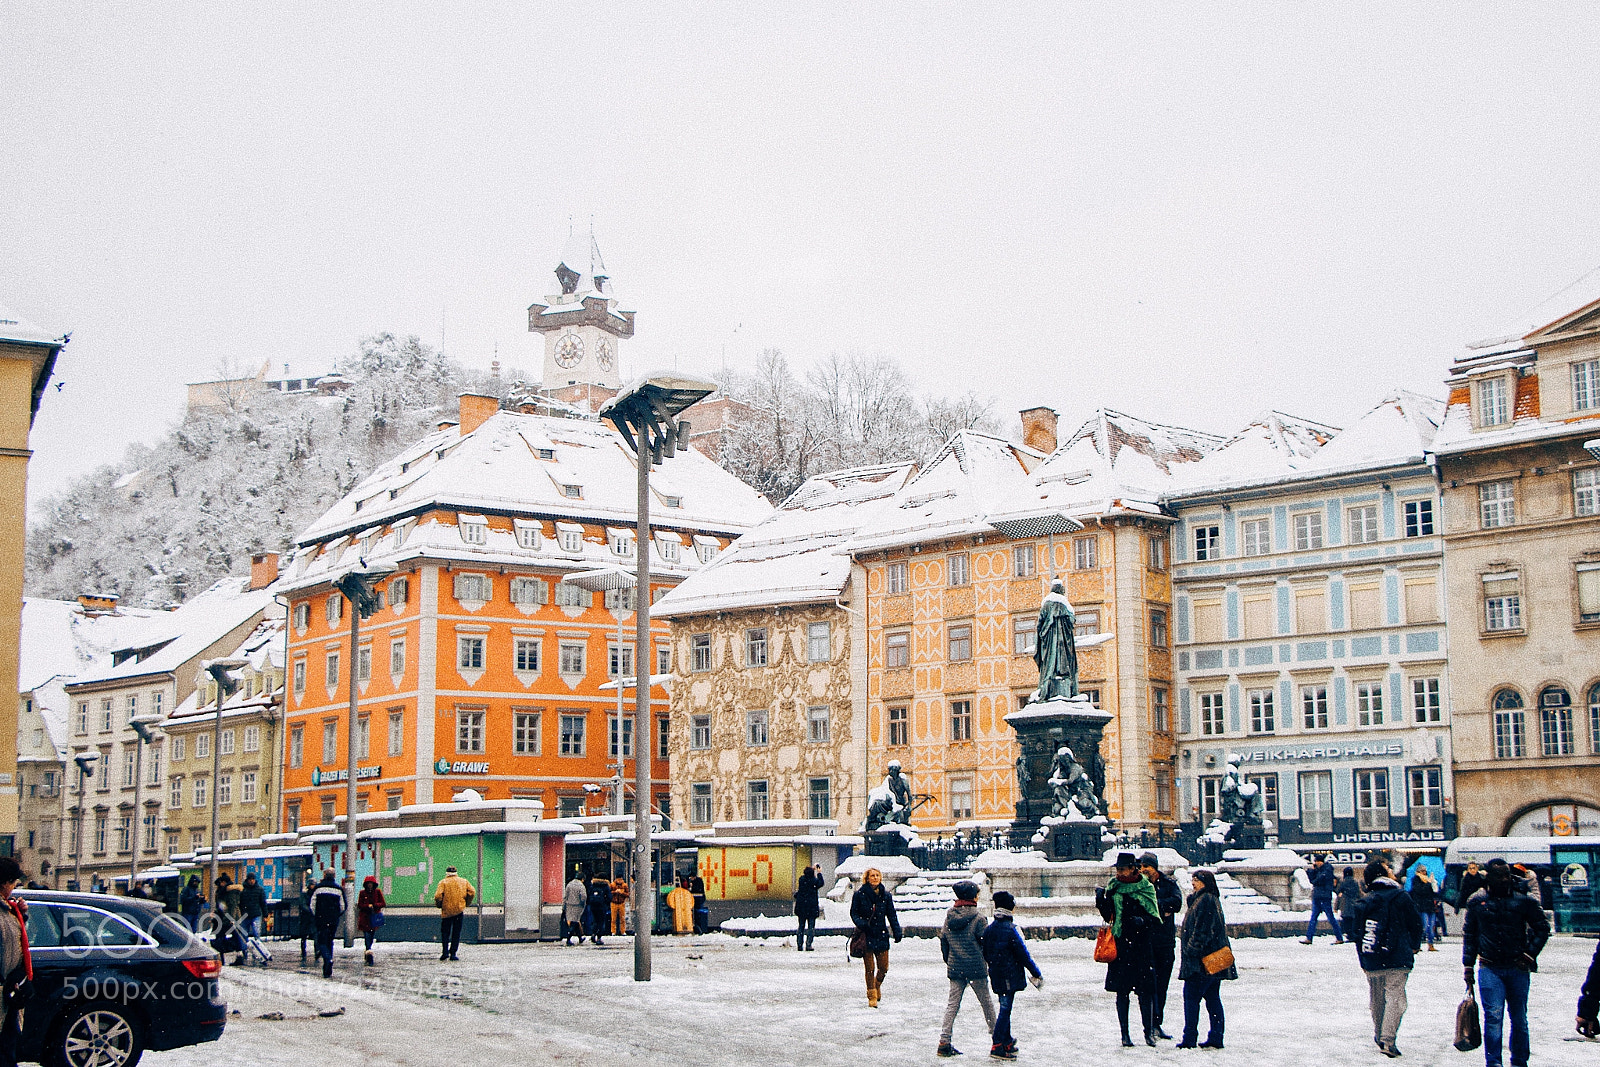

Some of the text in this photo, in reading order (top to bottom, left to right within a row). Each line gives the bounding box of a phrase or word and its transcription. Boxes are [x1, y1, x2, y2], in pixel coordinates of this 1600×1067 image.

[1344, 743, 1402, 756] HAUS
[452, 761, 490, 773] GRAWE
[651, 824, 657, 834] 2
[1333, 831, 1445, 843] UHRENHAUS
[1361, 919, 1378, 954] PUMA
